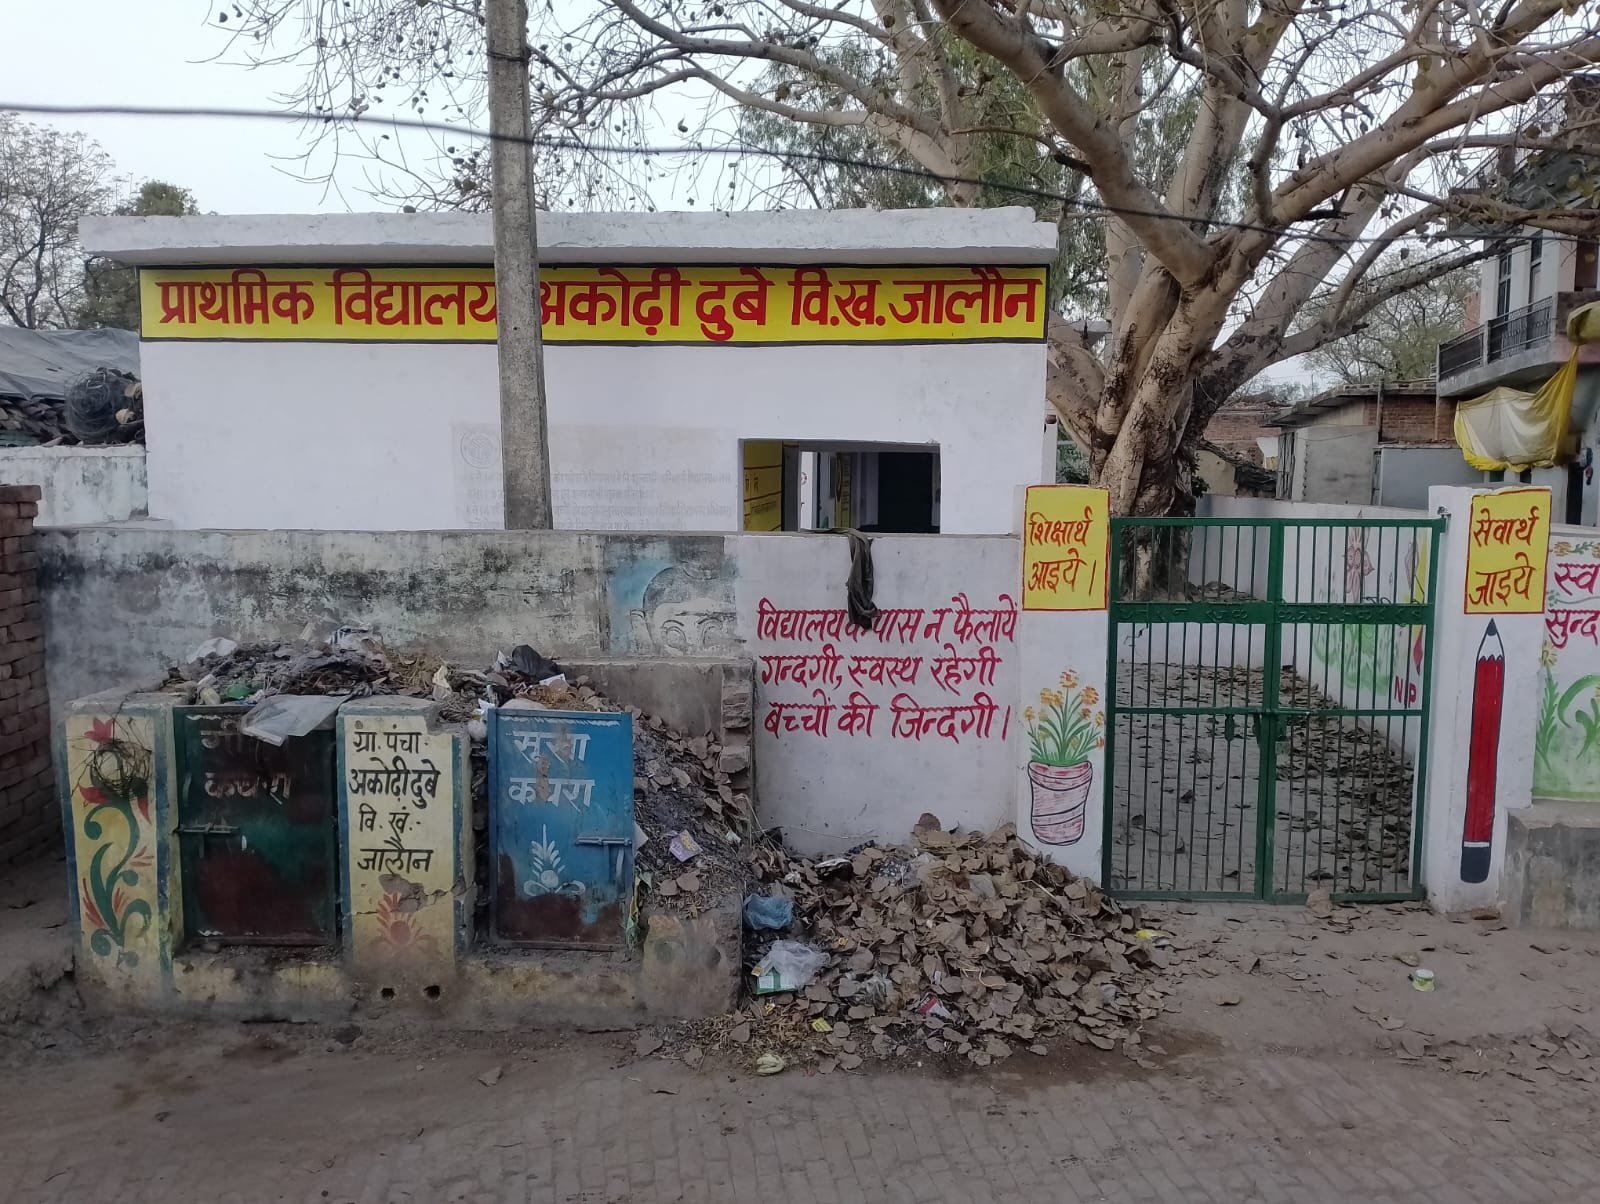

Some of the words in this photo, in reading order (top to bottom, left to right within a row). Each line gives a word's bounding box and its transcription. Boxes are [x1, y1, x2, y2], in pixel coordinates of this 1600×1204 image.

[155, 268, 315, 325] प्राथमिक
[324, 268, 497, 326] विद्यालय
[540, 268, 691, 336] अकोढ़ी
[695, 268, 774, 341] दुबे
[889, 266, 1043, 327] जालौन
[1028, 505, 1093, 546] शिक्षार्थ
[1473, 506, 1540, 547] सेवार्थ
[1469, 552, 1536, 606] जाइये
[1554, 563, 1600, 596] स्व
[757, 597, 848, 642] विद्यालय
[872, 608, 926, 644] पास
[923, 608, 953, 643] न
[1545, 609, 1600, 648] सुन्द
[848, 655, 923, 688] स्वस्थ
[930, 643, 1003, 696] रहेगी
[764, 688, 837, 738] बच्चों
[837, 691, 880, 737] की
